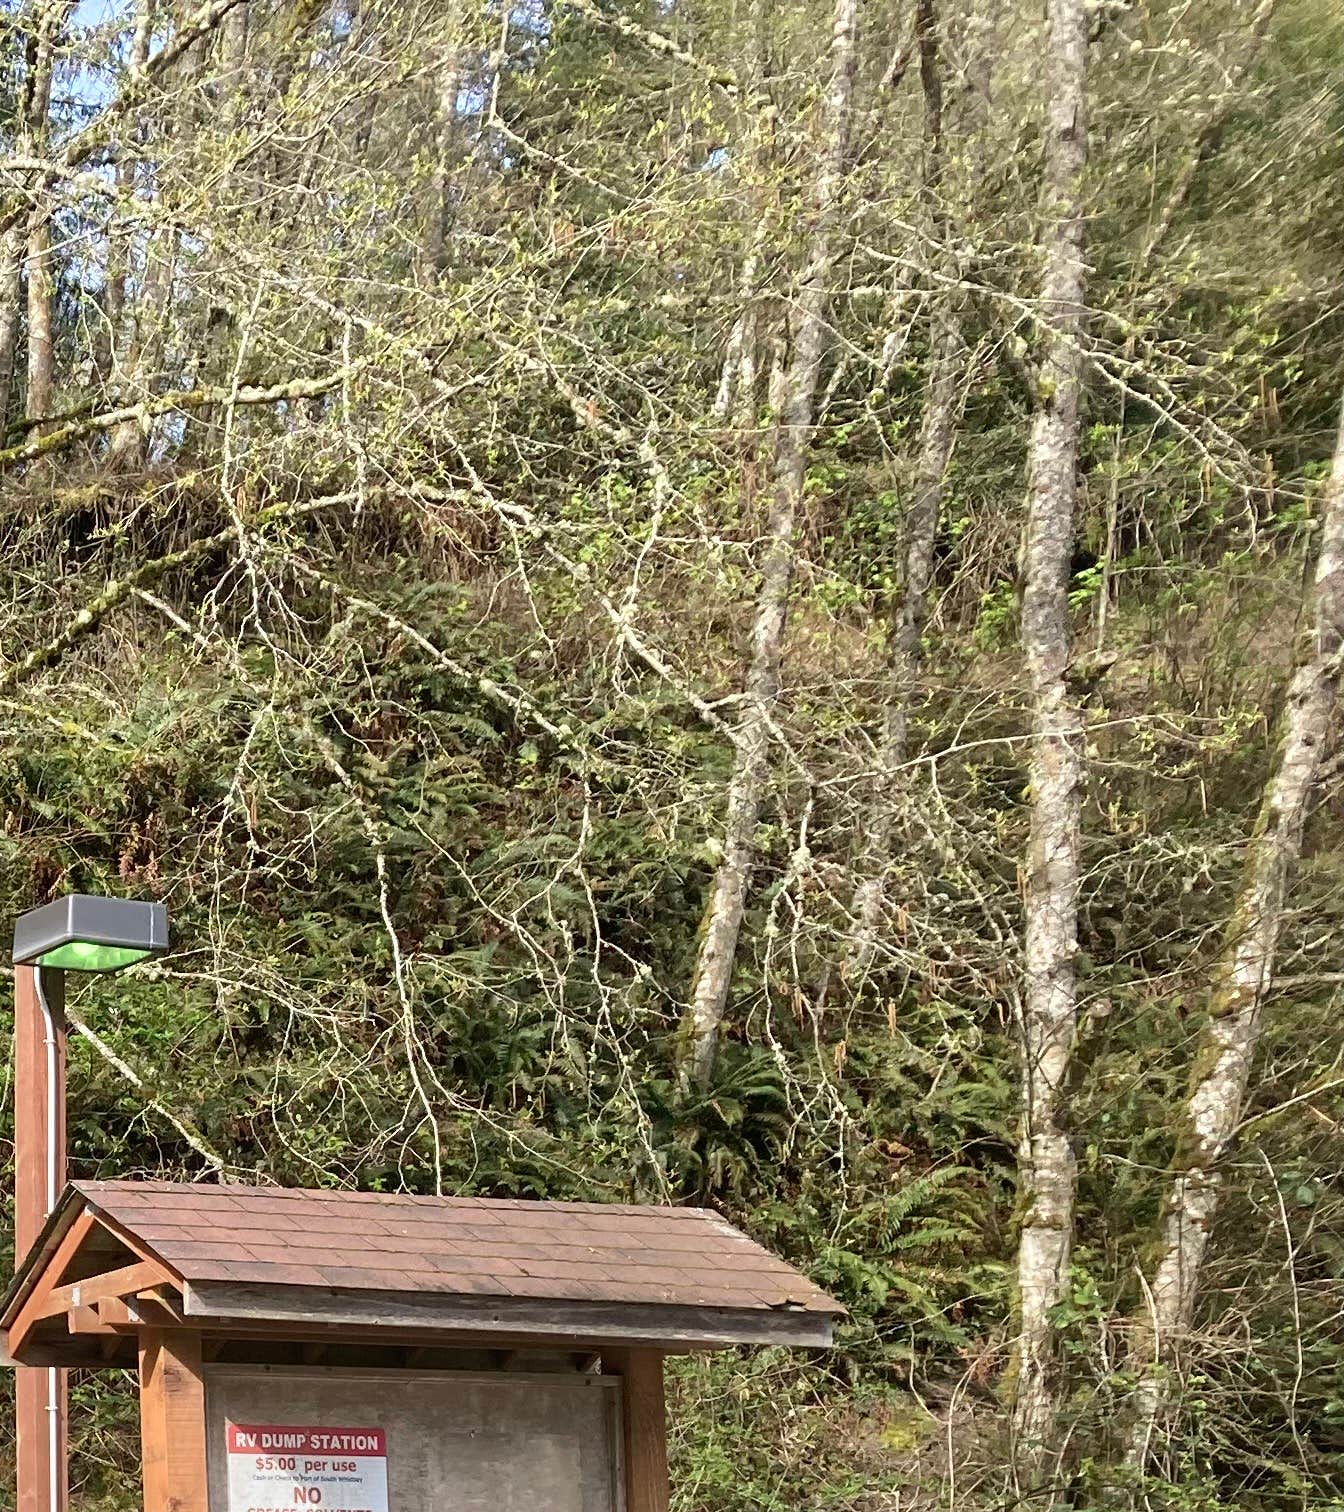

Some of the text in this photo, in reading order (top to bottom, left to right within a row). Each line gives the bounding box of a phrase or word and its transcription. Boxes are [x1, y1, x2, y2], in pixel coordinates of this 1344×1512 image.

[235, 1432, 379, 1451] RV DUMP STATION
[255, 1457, 357, 1474] $5.00 per use
[293, 1486, 322, 1504] NO
